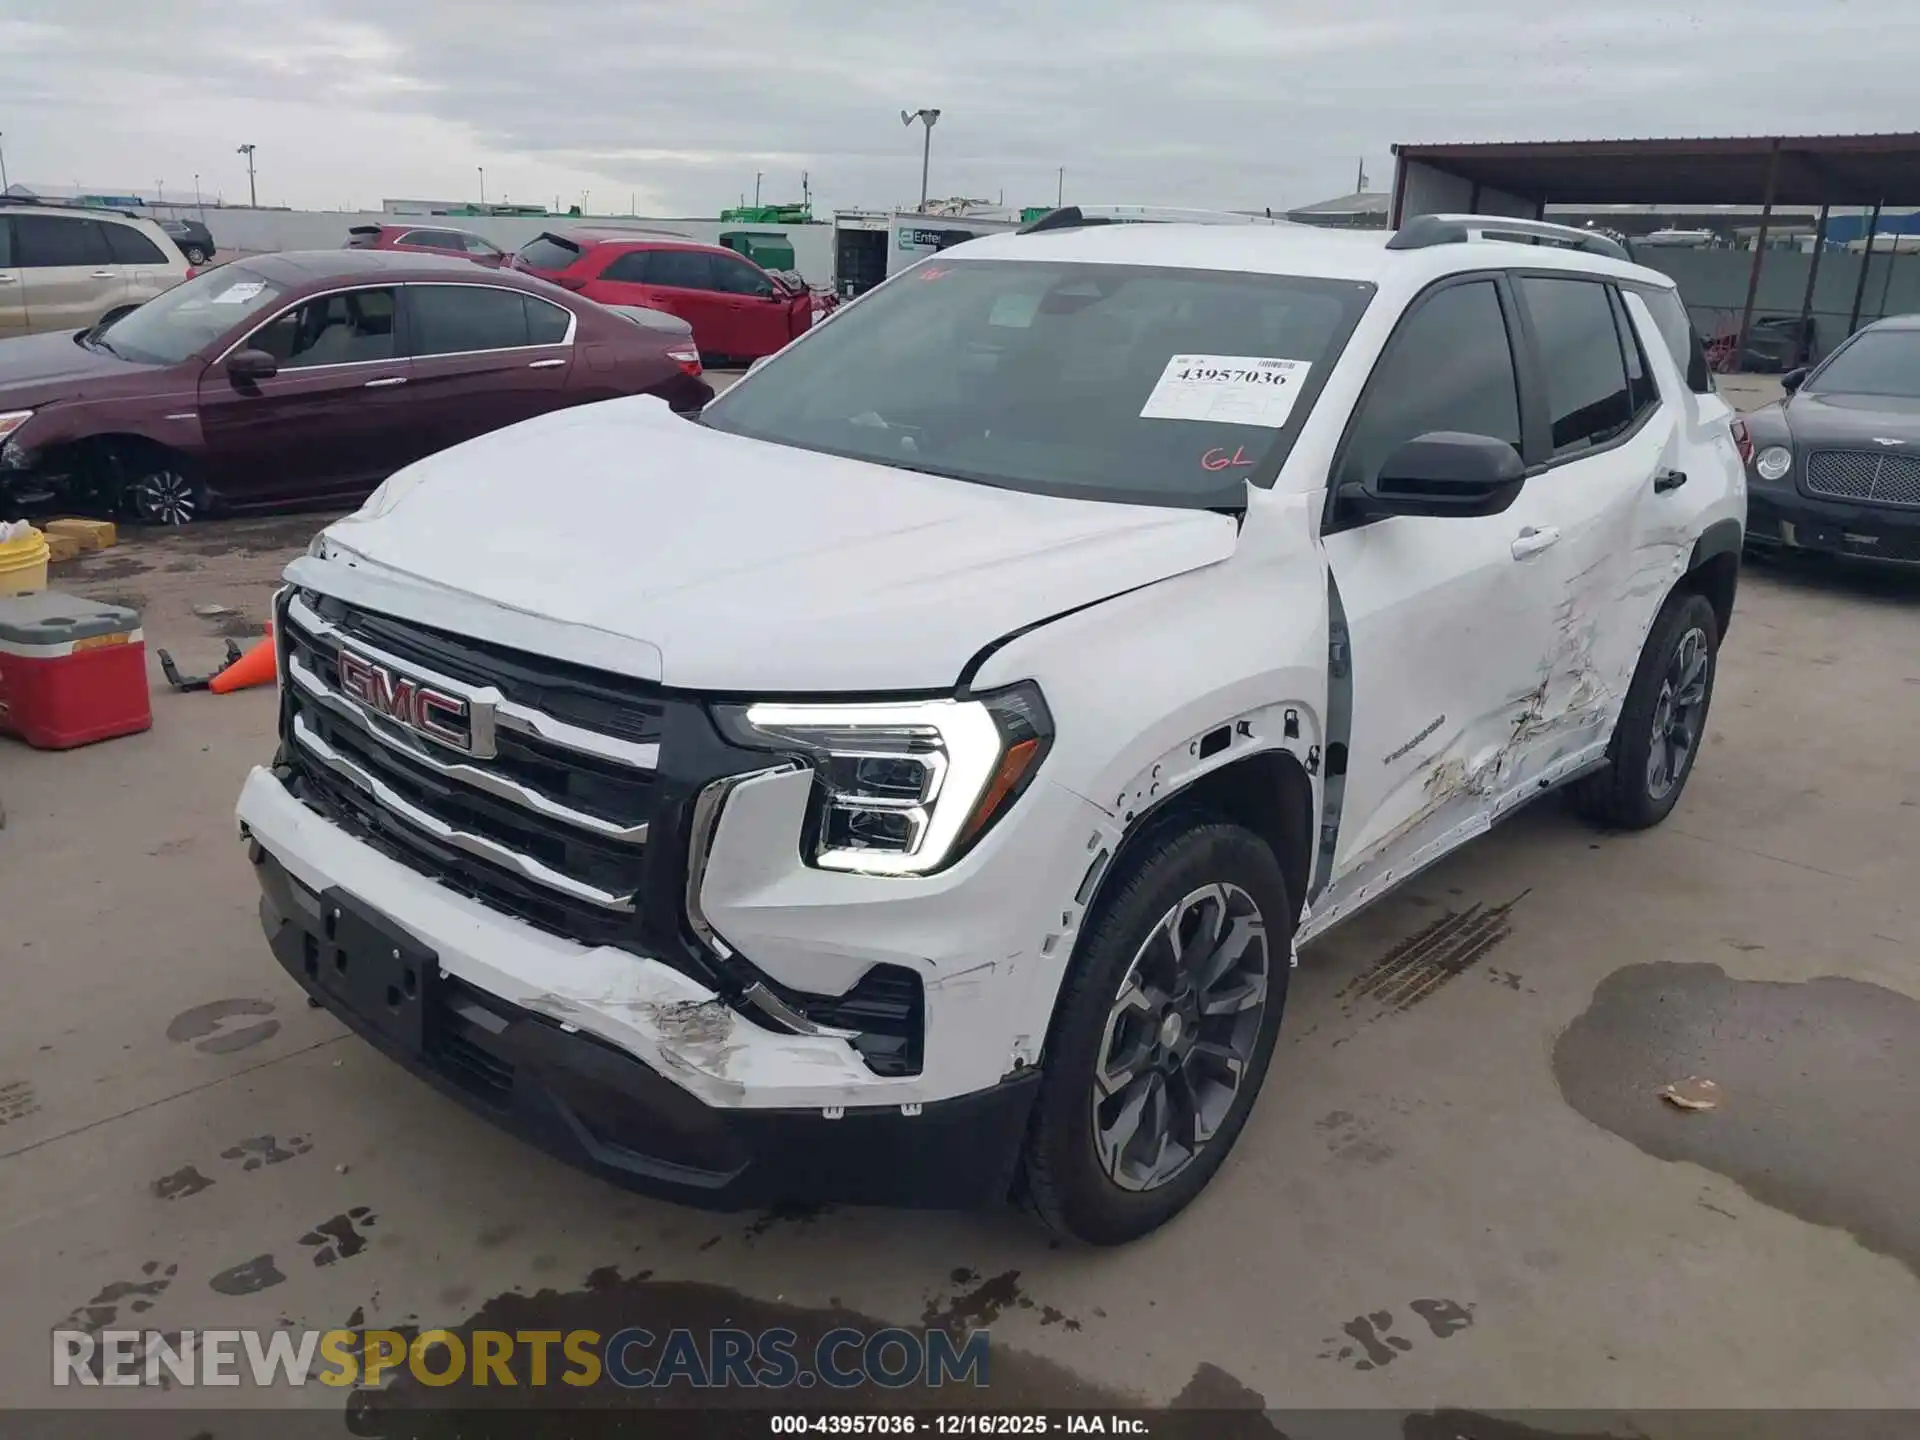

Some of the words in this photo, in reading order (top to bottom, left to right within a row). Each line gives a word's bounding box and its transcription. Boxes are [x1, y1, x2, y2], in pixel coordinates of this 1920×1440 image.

[1177, 367, 1288, 386] 43957036
[1201, 445, 1257, 471] GL
[338, 649, 468, 747] GMC
